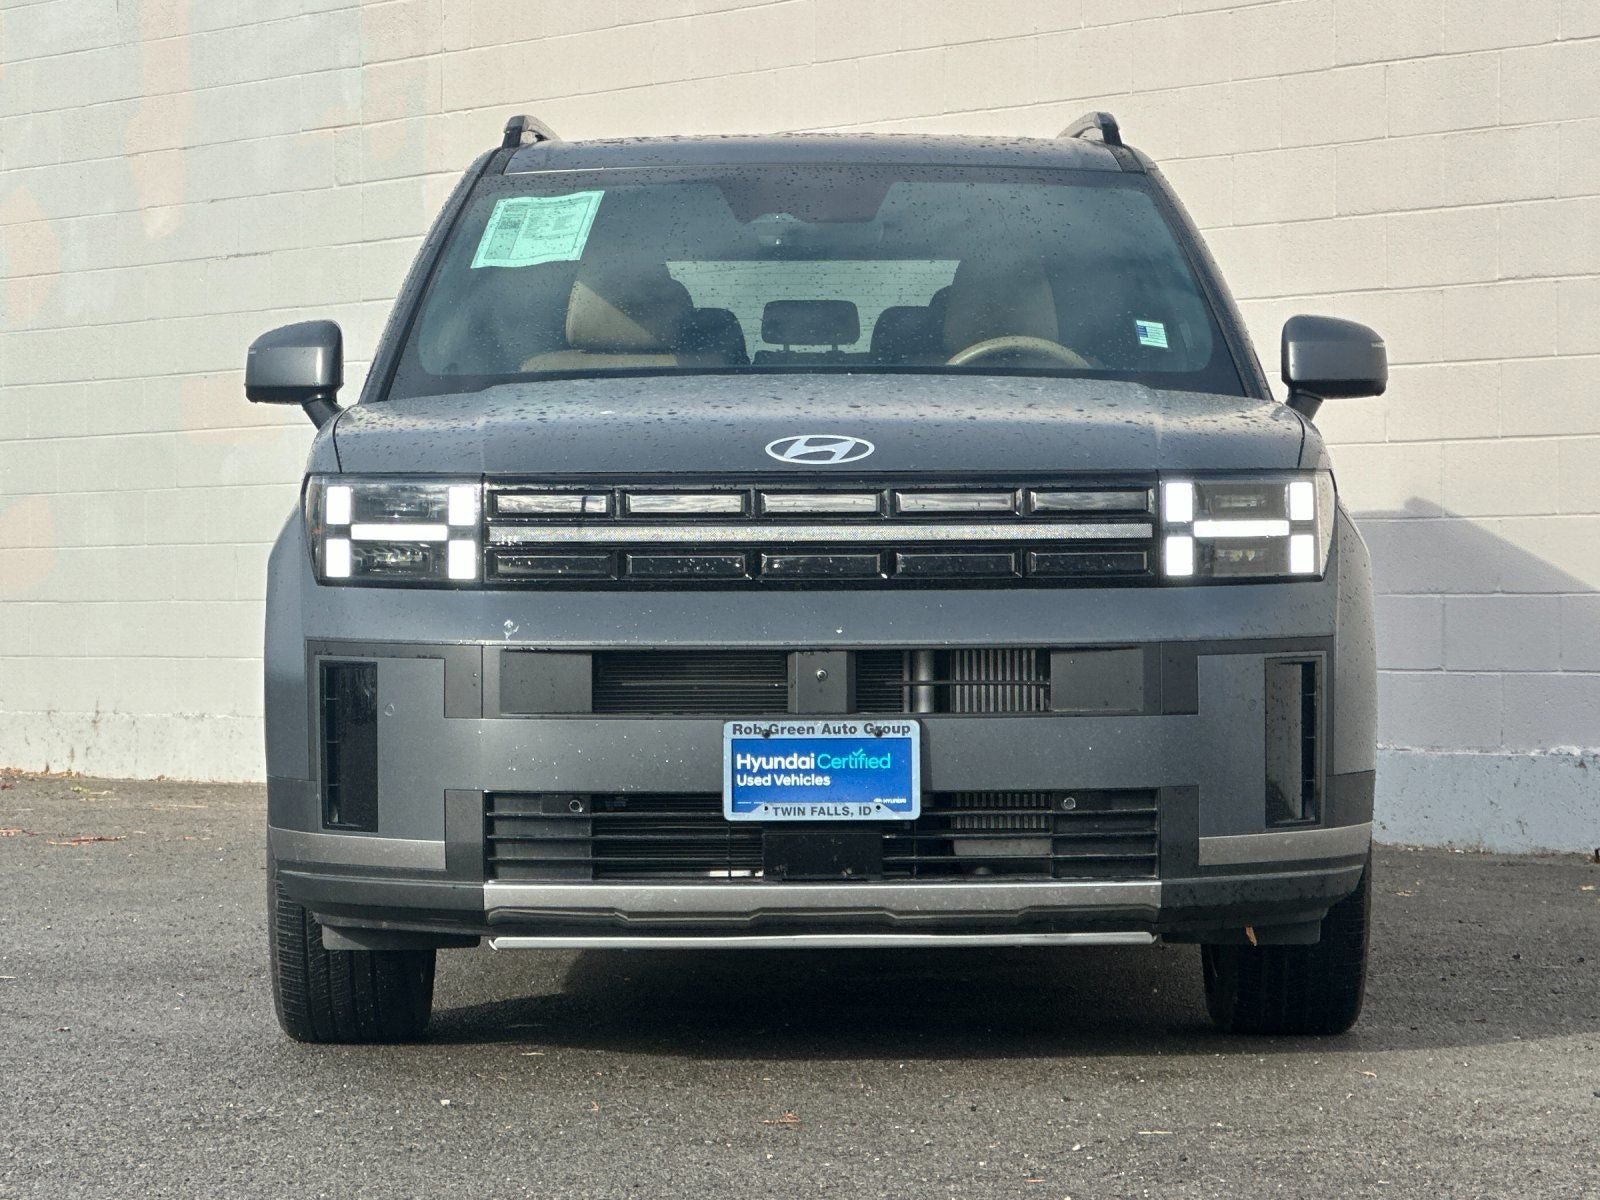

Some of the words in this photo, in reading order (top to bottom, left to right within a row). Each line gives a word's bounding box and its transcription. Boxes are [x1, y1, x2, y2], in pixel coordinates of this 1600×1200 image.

[732, 723, 763, 735] Rob
[769, 723, 815, 735] Green
[820, 723, 857, 735] Auto
[736, 753, 815, 773] Hyundai
[817, 749, 891, 769] Certified
[736, 774, 771, 786] Used
[774, 773, 831, 786] Vehicles
[773, 806, 806, 816] TWIN
[810, 806, 854, 817] FALLS,
[858, 806, 872, 816] ID
